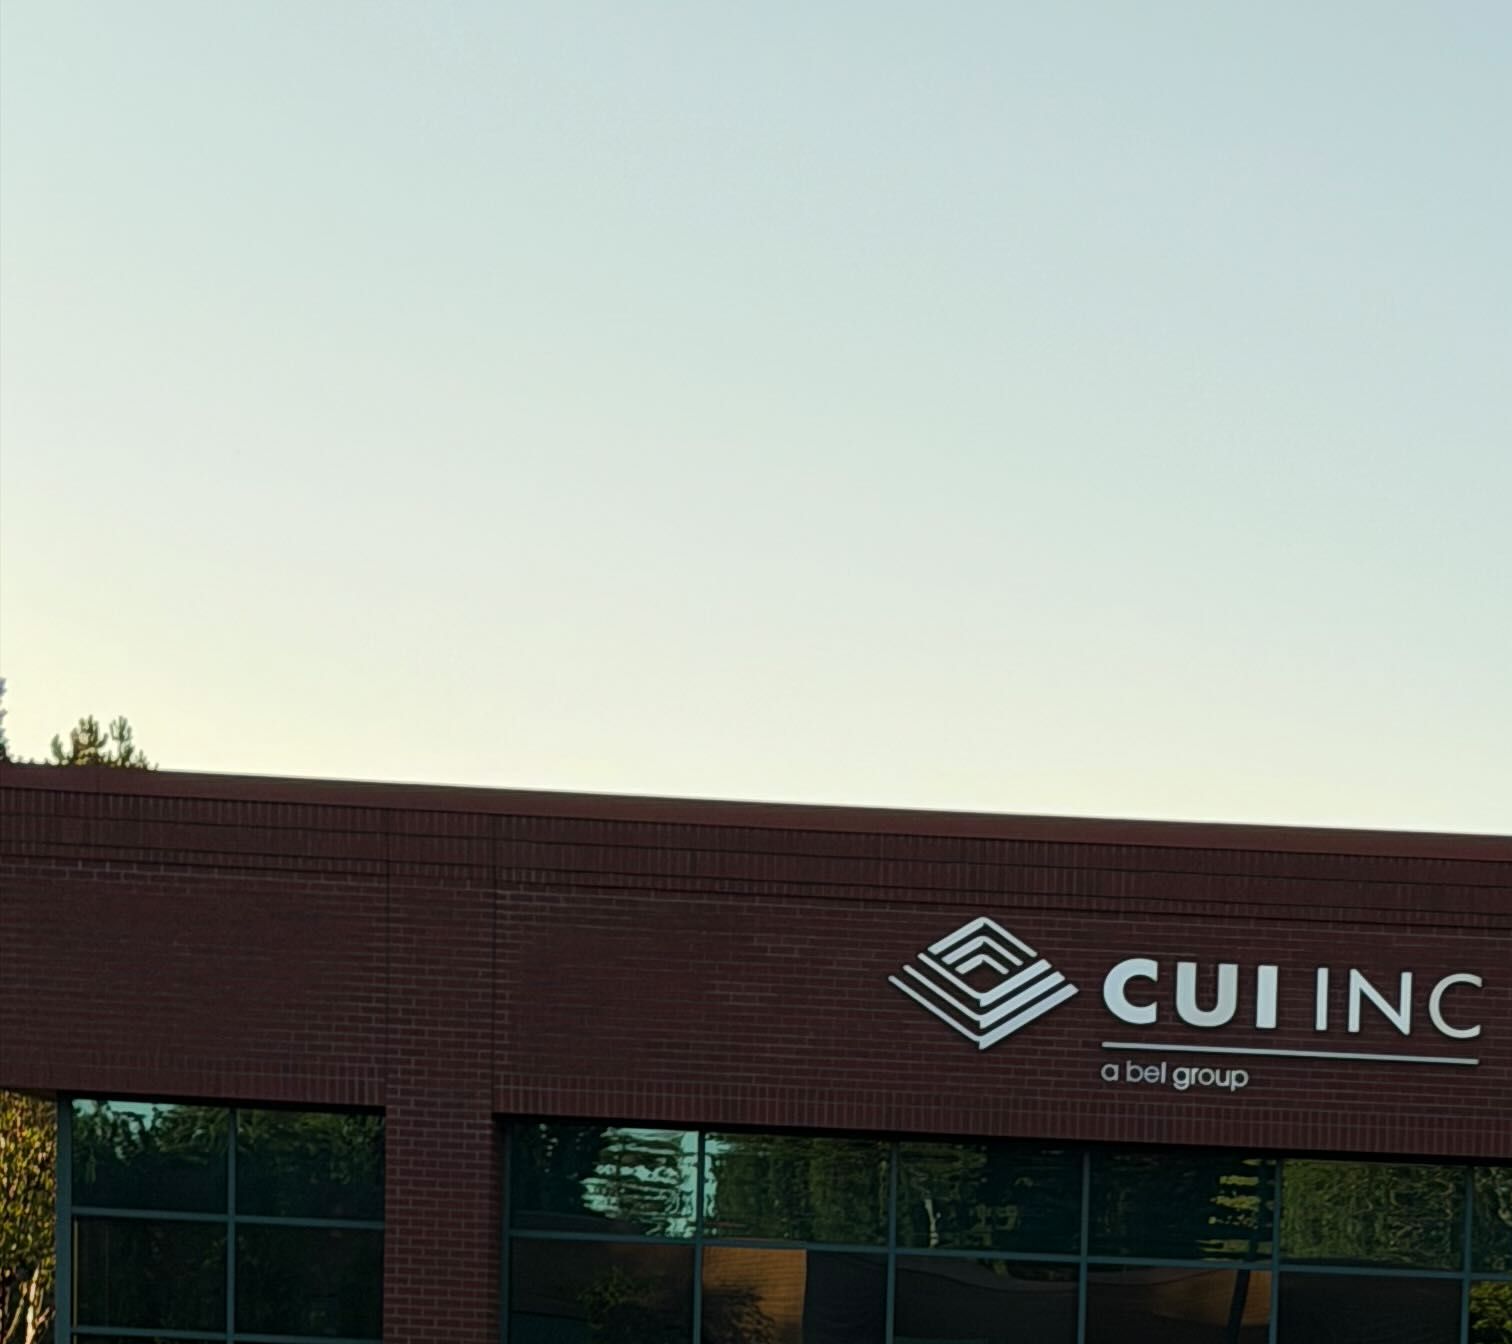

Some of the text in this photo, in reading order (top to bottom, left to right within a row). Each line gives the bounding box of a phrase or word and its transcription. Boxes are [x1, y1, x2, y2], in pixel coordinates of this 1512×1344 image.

[1102, 957, 1484, 1040] CUI INC
[1100, 1063, 1120, 1082] a
[1172, 1066, 1250, 1093] group
